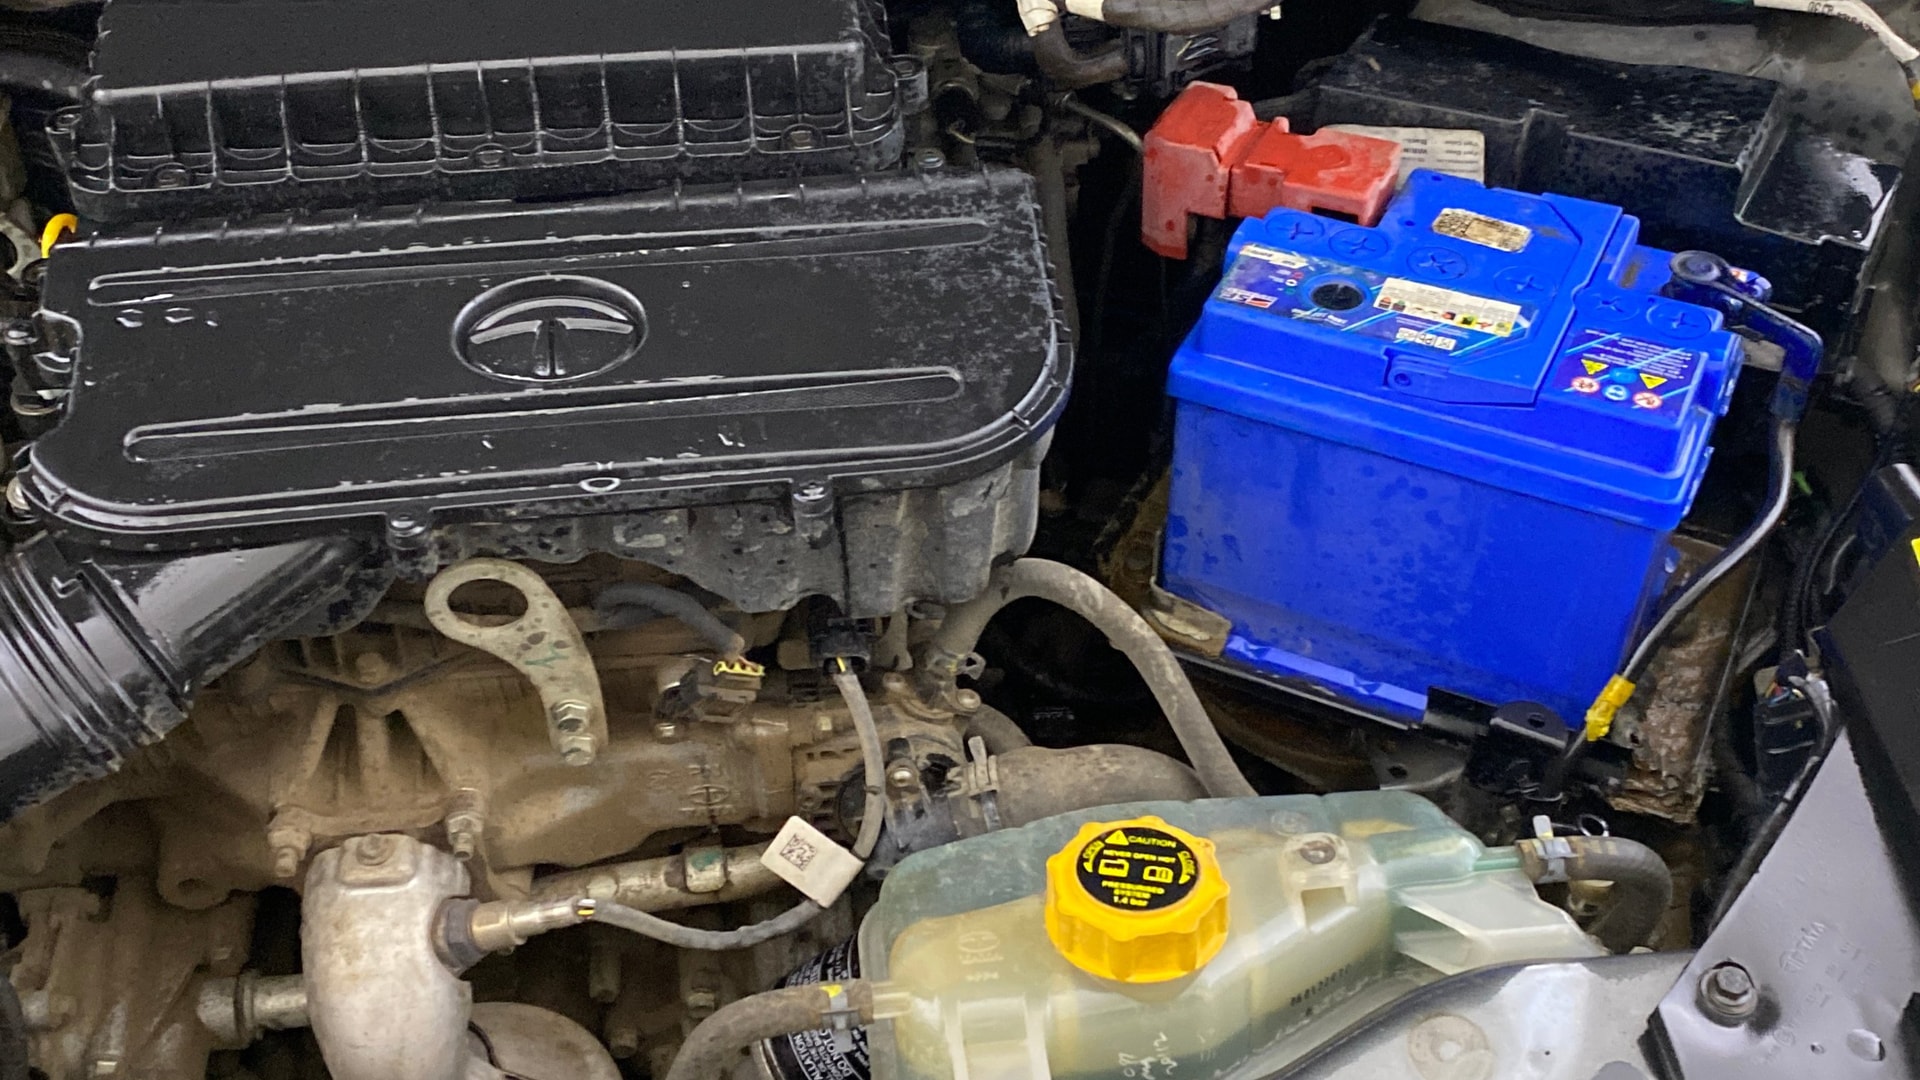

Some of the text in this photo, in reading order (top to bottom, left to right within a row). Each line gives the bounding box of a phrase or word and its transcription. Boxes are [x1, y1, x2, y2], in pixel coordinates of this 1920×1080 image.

[1128, 835, 1176, 848] CAUTION
[1103, 849, 1176, 864] NEVER OPEN HOT
[1113, 895, 1128, 904] 1.4
